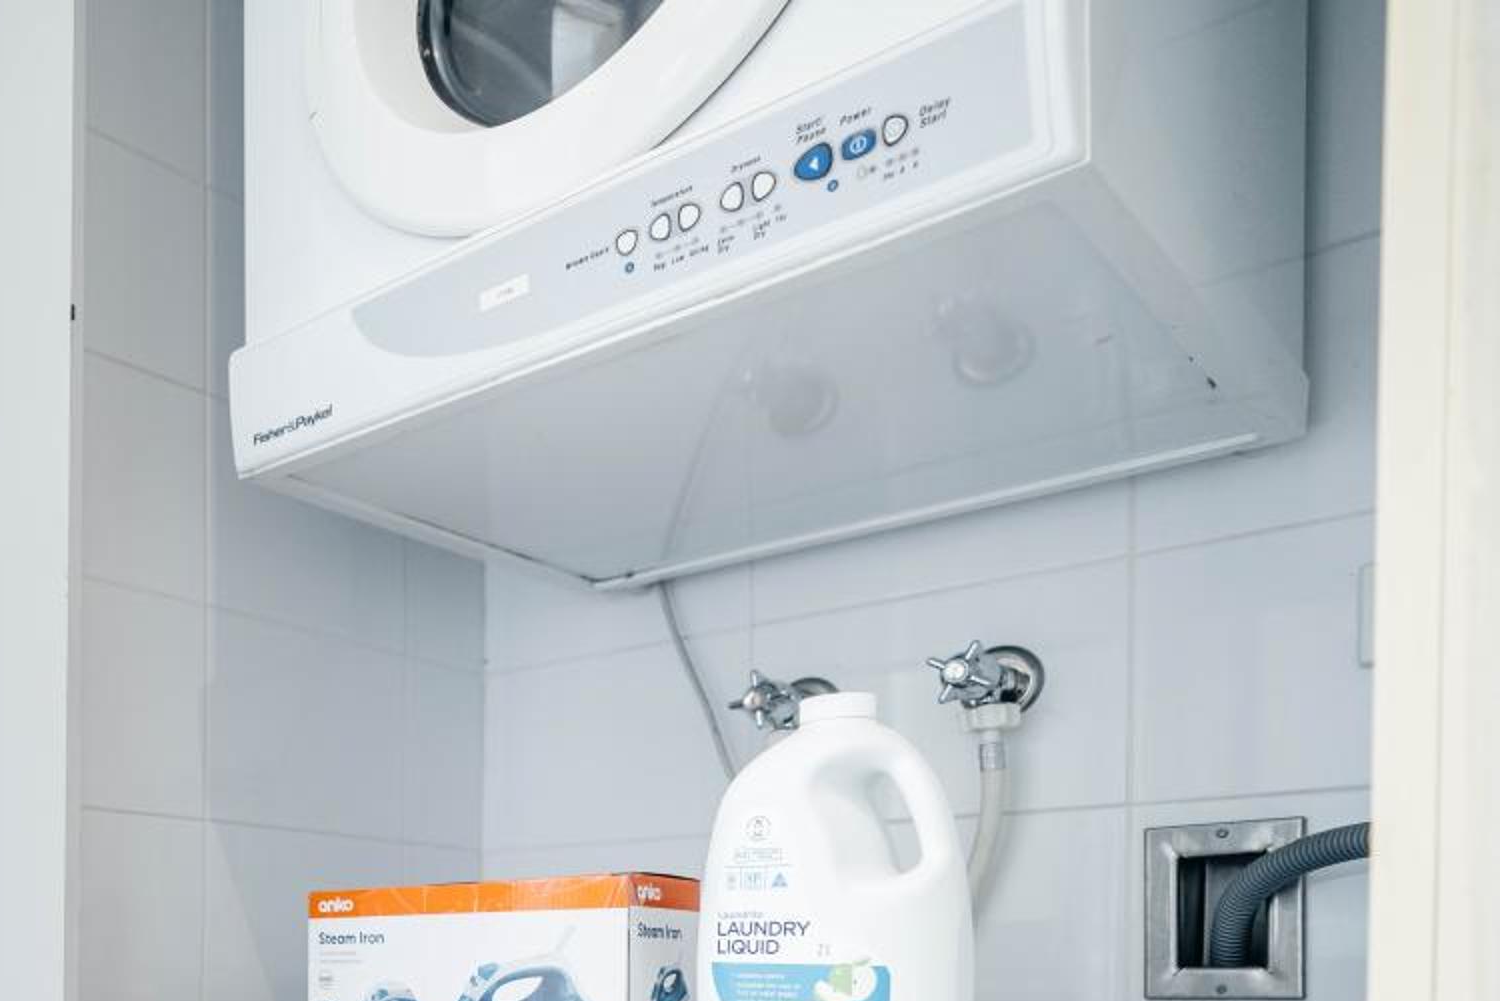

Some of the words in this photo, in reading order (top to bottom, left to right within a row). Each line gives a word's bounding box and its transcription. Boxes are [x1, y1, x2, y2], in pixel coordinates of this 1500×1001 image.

[918, 97, 951, 117] Delay
[839, 107, 872, 126] Power
[919, 111, 948, 129] Start
[317, 897, 355, 913] anko
[637, 922, 665, 939] Steam
[666, 924, 682, 940] Iron
[717, 920, 811, 937] LAUNDRY
[318, 930, 357, 945] Steam
[359, 930, 385, 945] Iron
[717, 938, 780, 955] LIQUID
